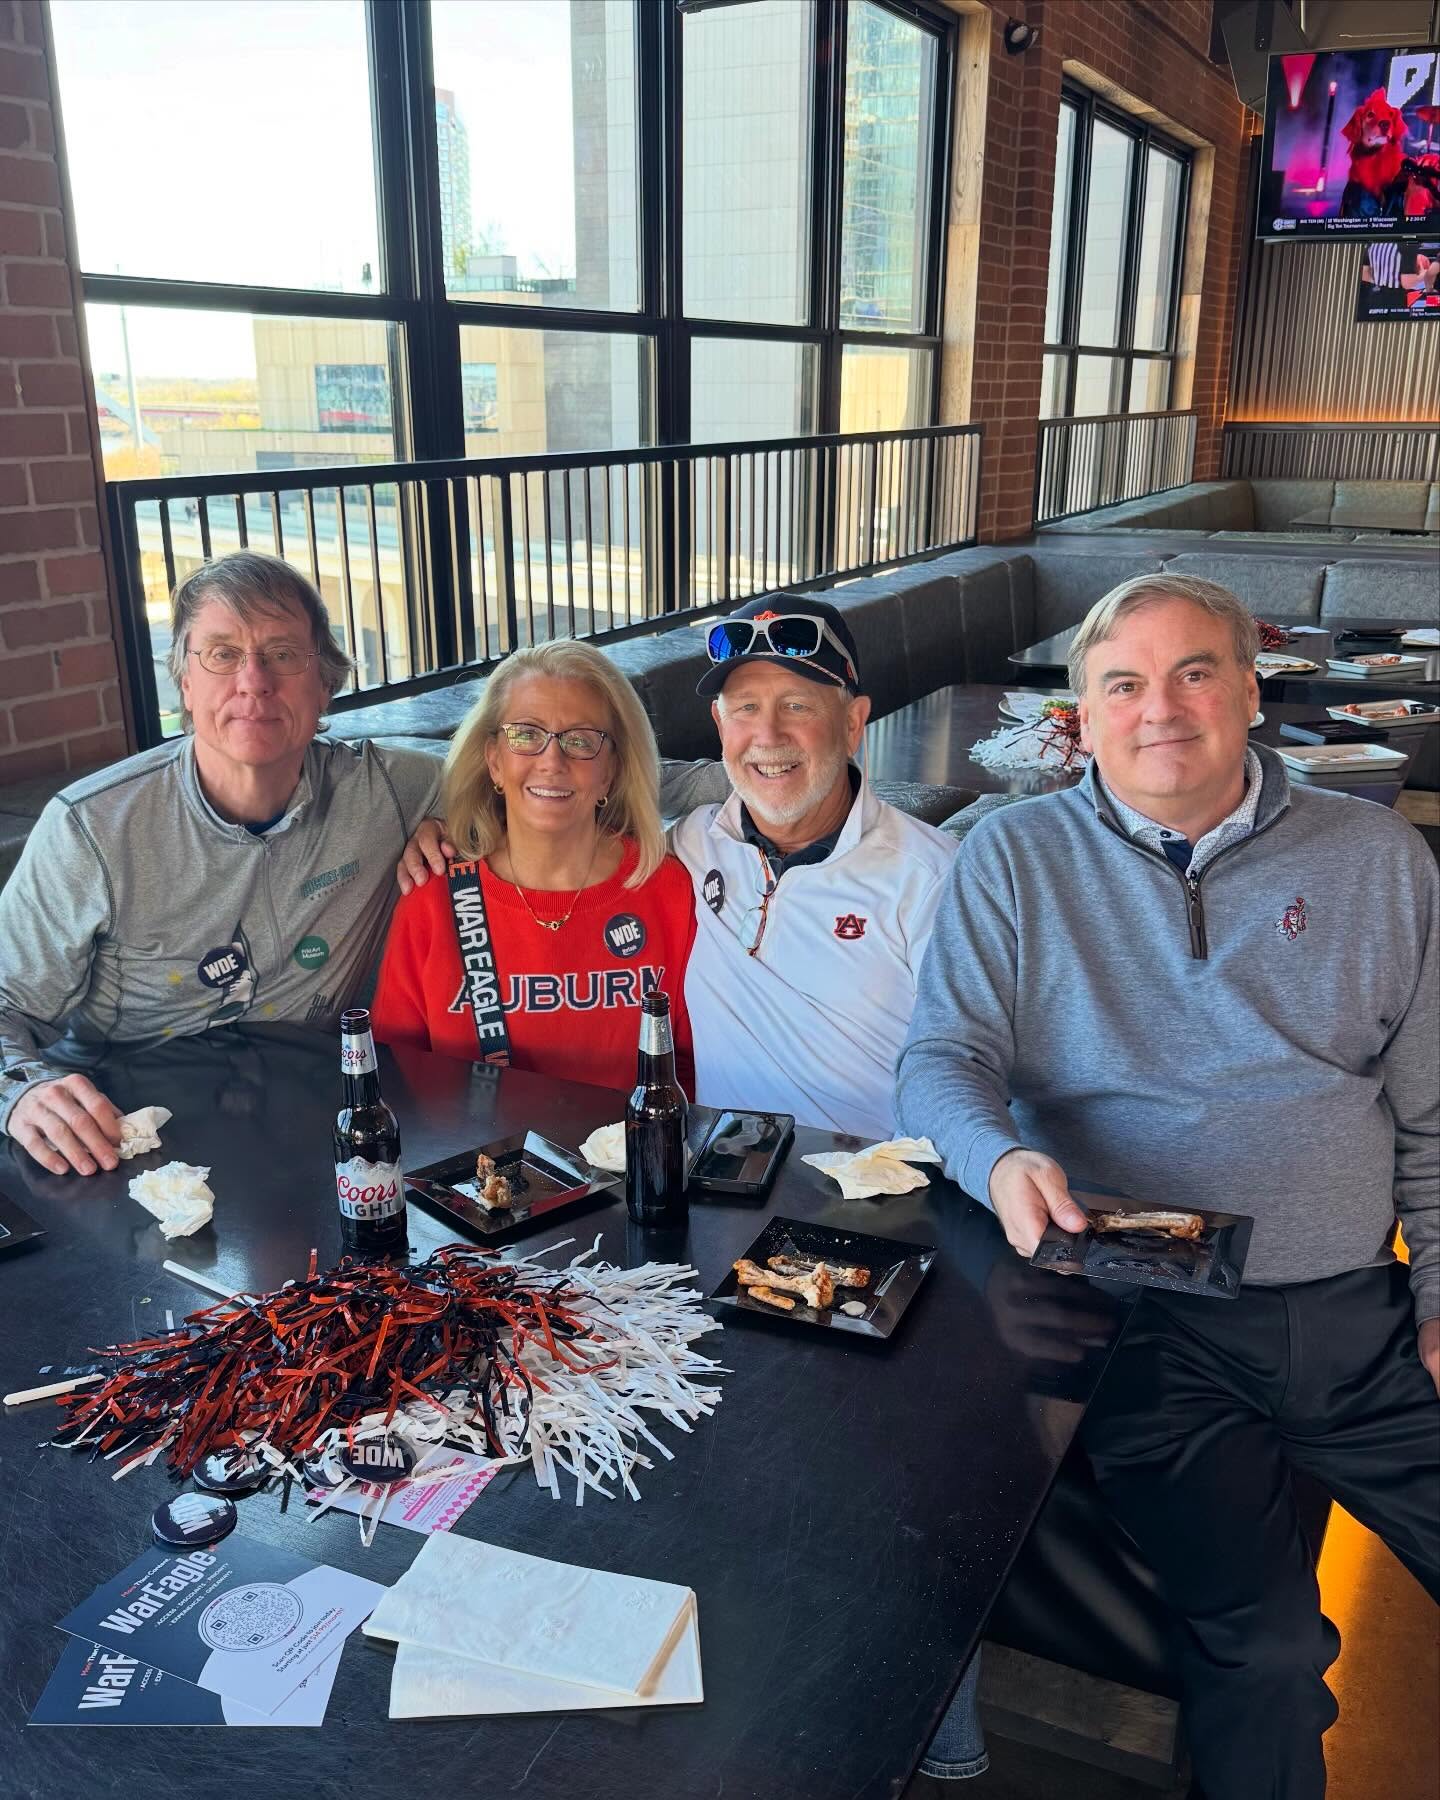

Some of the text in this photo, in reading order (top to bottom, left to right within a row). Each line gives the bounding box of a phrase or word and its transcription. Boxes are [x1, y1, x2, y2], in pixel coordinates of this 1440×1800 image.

[704, 877, 721, 902] WDE
[453, 886, 488, 950] WAR
[609, 921, 641, 947] WDE
[203, 953, 239, 980] WDE
[464, 951, 505, 1039] EAGLE
[338, 1175, 398, 1203] Coors
[341, 1198, 393, 1217] LIGHT
[351, 1444, 405, 1469] WDE
[133, 1574, 150, 1586] Than
[157, 1608, 177, 1626] ACCESS
[177, 1583, 207, 1607] DISCOUNTS
[207, 1563, 229, 1581] PRIORITY
[170, 1595, 205, 1624] EXPERIENCES
[205, 1570, 233, 1594] GIVEAWAYS
[87, 1648, 100, 1662] Than
[276, 1653, 300, 1673] Starting
[78, 1653, 139, 1709] WarE
[141, 1667, 154, 1688] ACCESS
